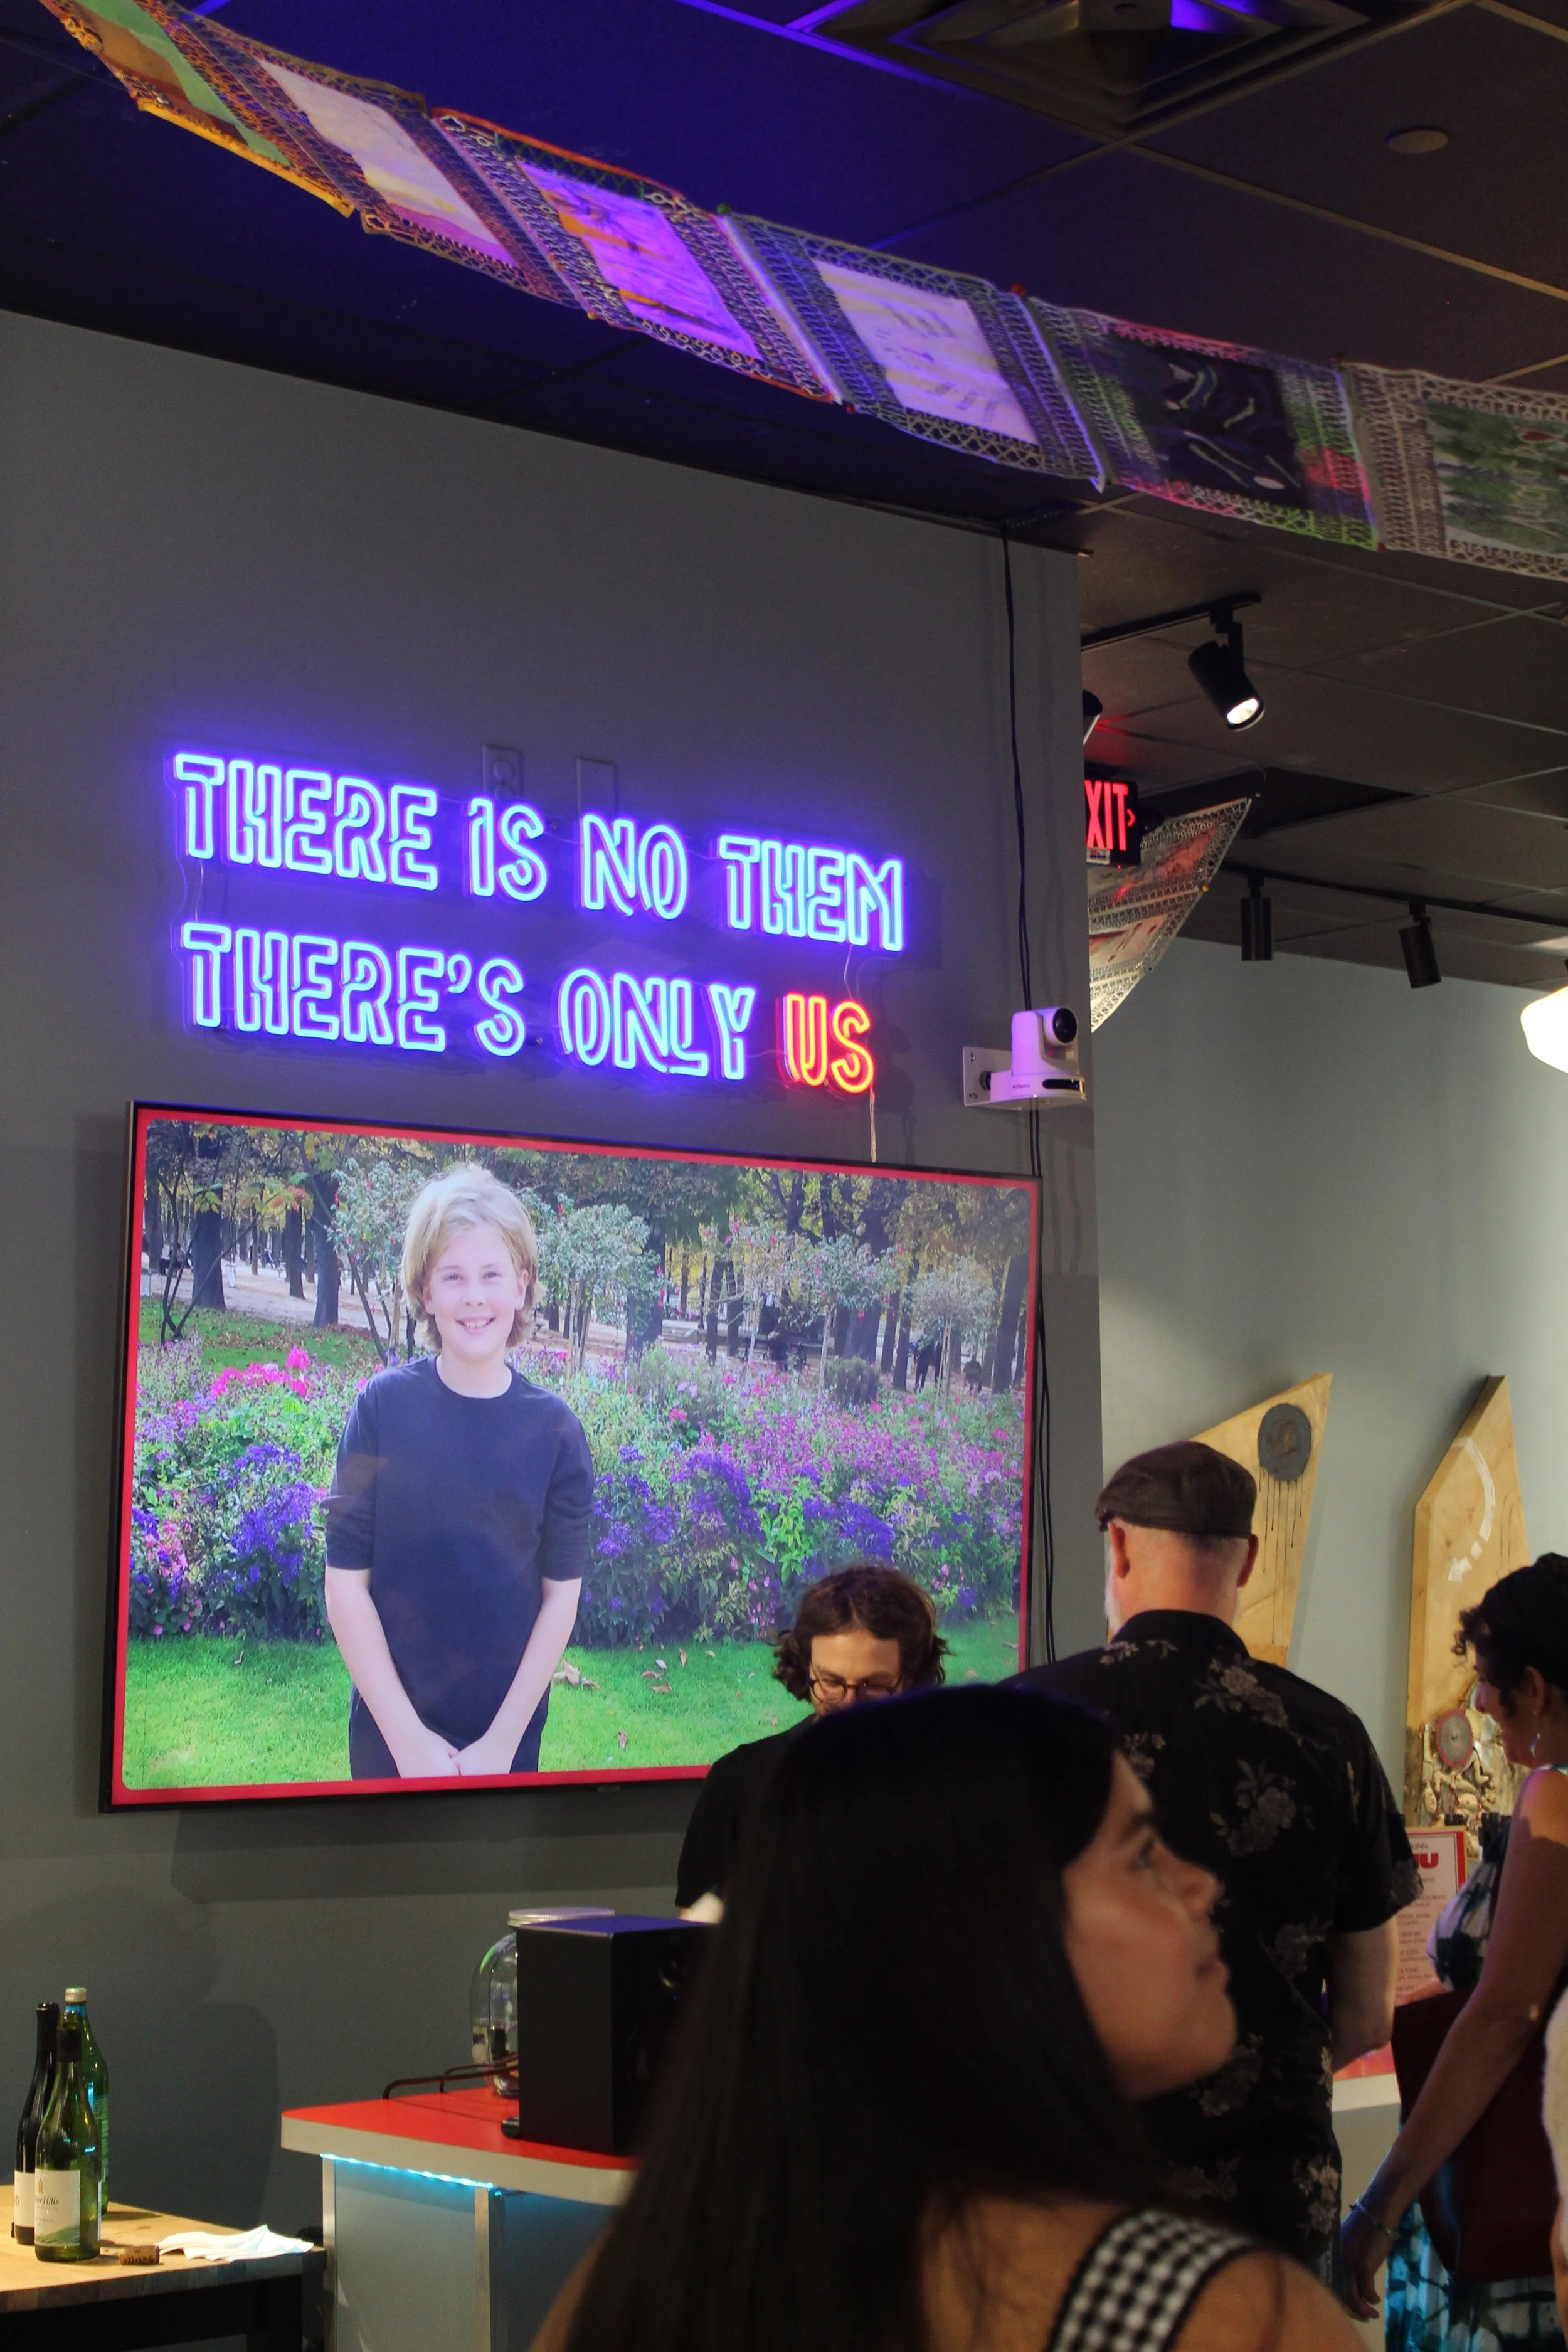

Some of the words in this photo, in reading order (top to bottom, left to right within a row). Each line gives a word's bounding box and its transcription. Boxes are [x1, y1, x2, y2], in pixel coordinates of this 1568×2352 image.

[172, 751, 439, 891] THERE
[467, 797, 548, 902] IS
[580, 813, 689, 920] NO
[716, 834, 904, 952] THEM
[1084, 780, 1128, 852] XIT
[181, 922, 526, 1057] THERE'S
[558, 967, 756, 1081] ONLY
[781, 992, 874, 1094] US
